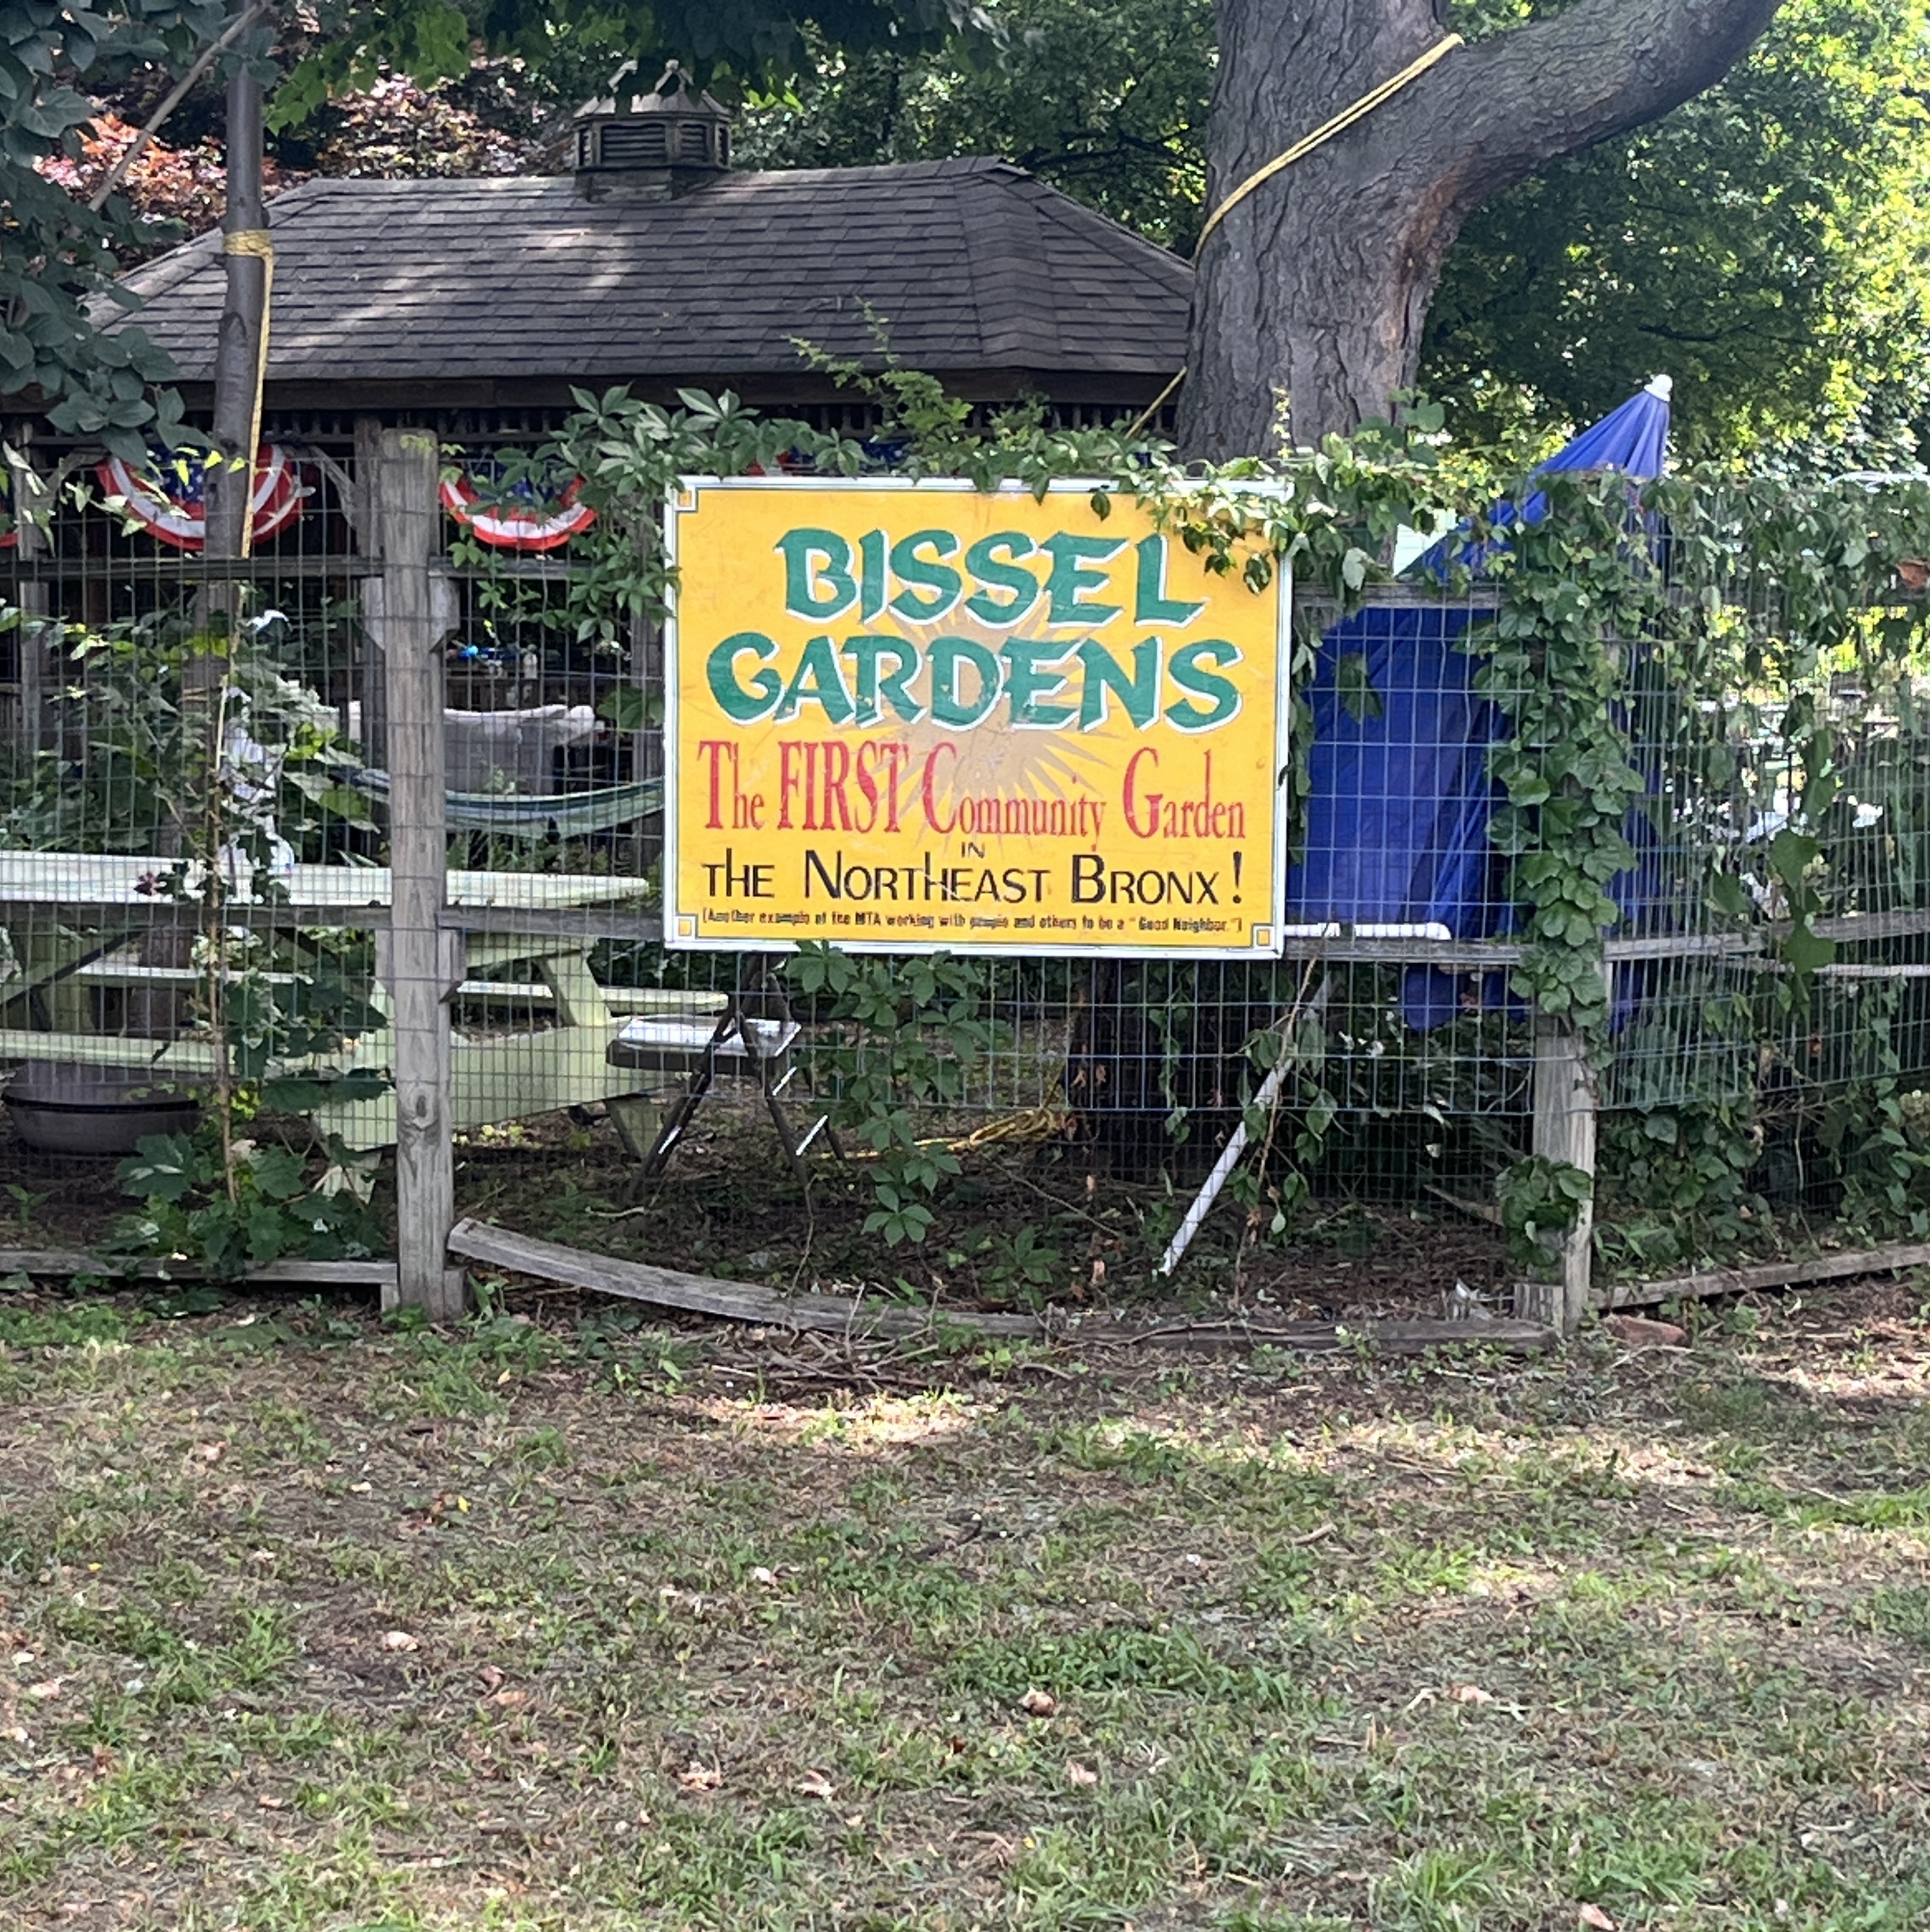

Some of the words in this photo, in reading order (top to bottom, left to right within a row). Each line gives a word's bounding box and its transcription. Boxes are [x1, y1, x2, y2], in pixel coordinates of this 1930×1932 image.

[775, 527, 1208, 627] BISSEL
[706, 632, 1244, 733] GARDENS
[697, 740, 765, 830] The
[777, 740, 909, 834] FIRST
[922, 742, 1106, 852] Community
[1122, 746, 1245, 839] Garden
[701, 848, 775, 897] THE
[805, 849, 1051, 903] NORTHEAST
[961, 842, 985, 858] IN
[759, 910, 810, 926] example
[816, 911, 826, 925] of
[832, 911, 850, 925] the
[855, 911, 881, 926] MTA
[885, 912, 934, 929] working
[939, 913, 966, 927] with
[1014, 915, 1035, 929] and
[1039, 915, 1077, 930] others
[1082, 915, 1095, 929] to
[1098, 915, 1112, 930] be
[1117, 918, 1125, 931] a
